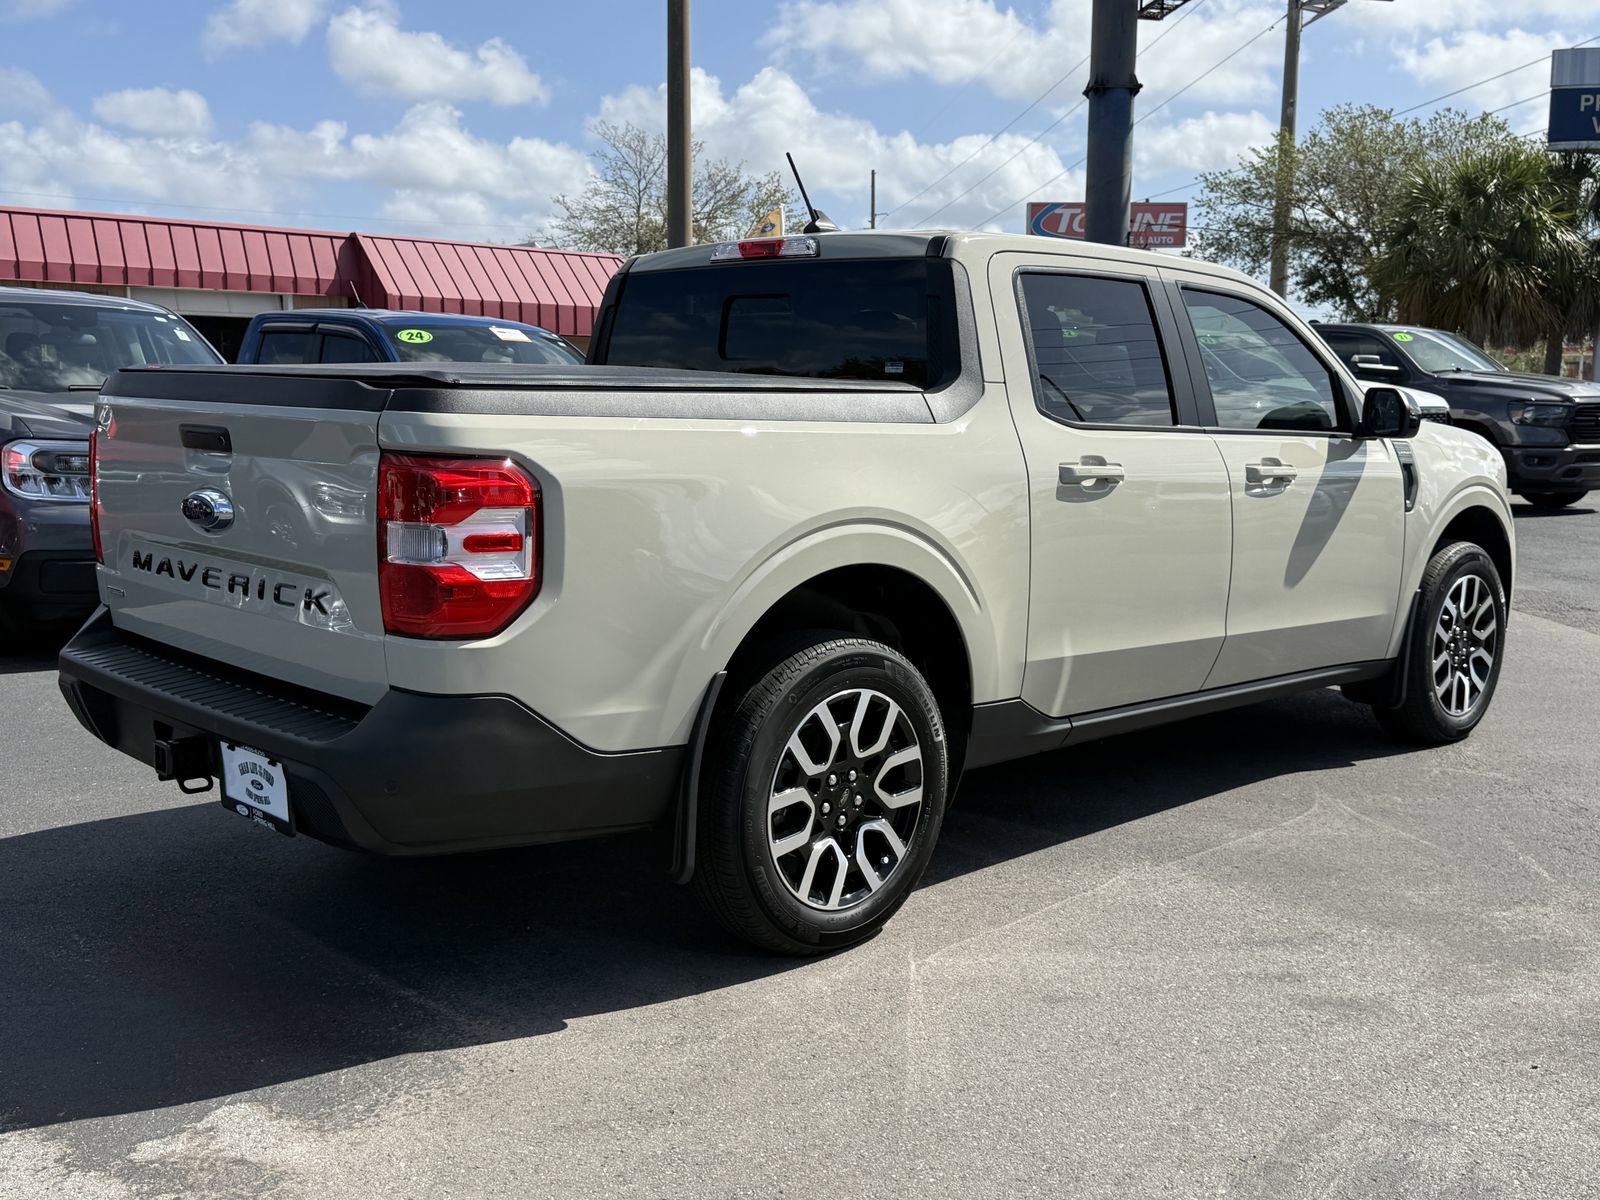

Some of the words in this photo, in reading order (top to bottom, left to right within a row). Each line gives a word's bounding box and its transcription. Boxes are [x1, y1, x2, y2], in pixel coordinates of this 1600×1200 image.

[1148, 235, 1174, 244] AUTO
[406, 332, 424, 341] 24
[132, 550, 330, 615] MAVERICK
